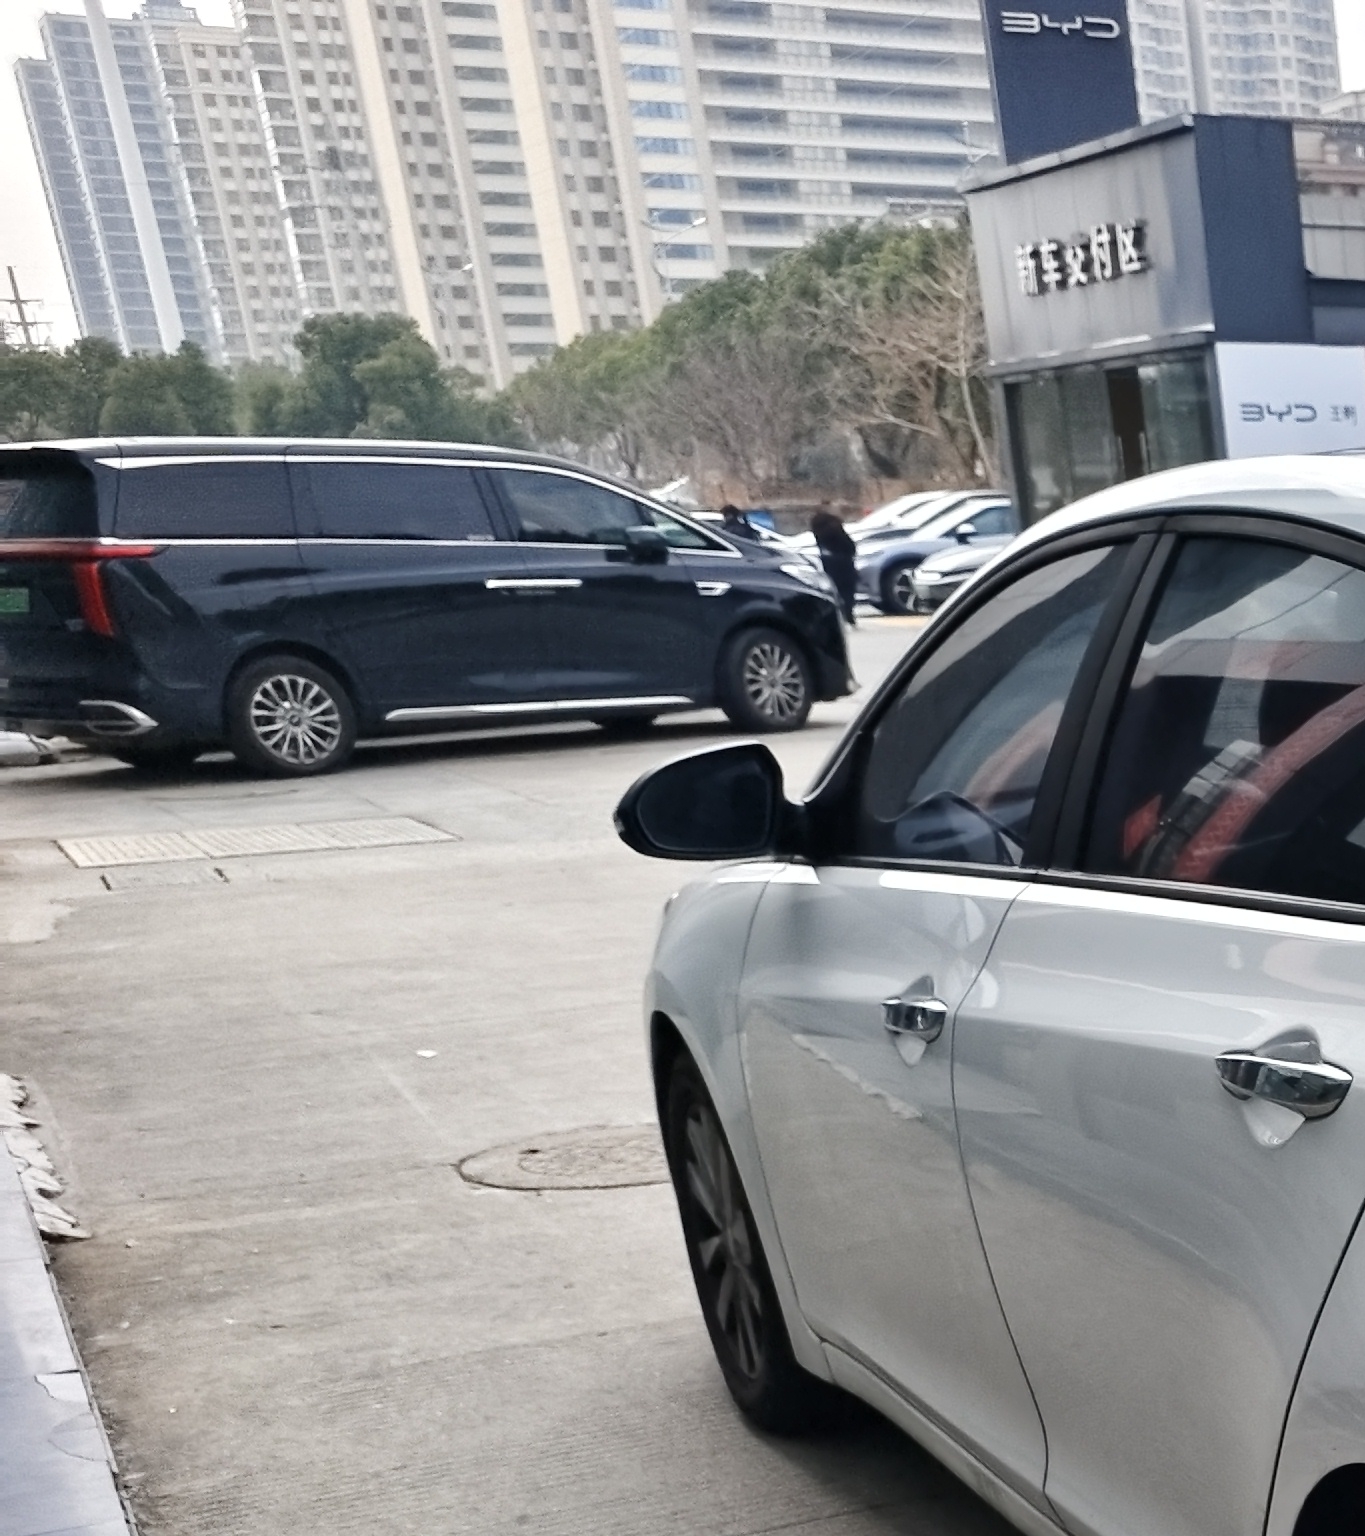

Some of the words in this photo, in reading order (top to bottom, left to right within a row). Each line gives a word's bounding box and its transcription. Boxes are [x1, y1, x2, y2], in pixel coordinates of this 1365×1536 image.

[1001, 11, 1120, 38] BYD
[1014, 219, 1142, 294] 新车交付区
[1240, 404, 1317, 422] BYD
